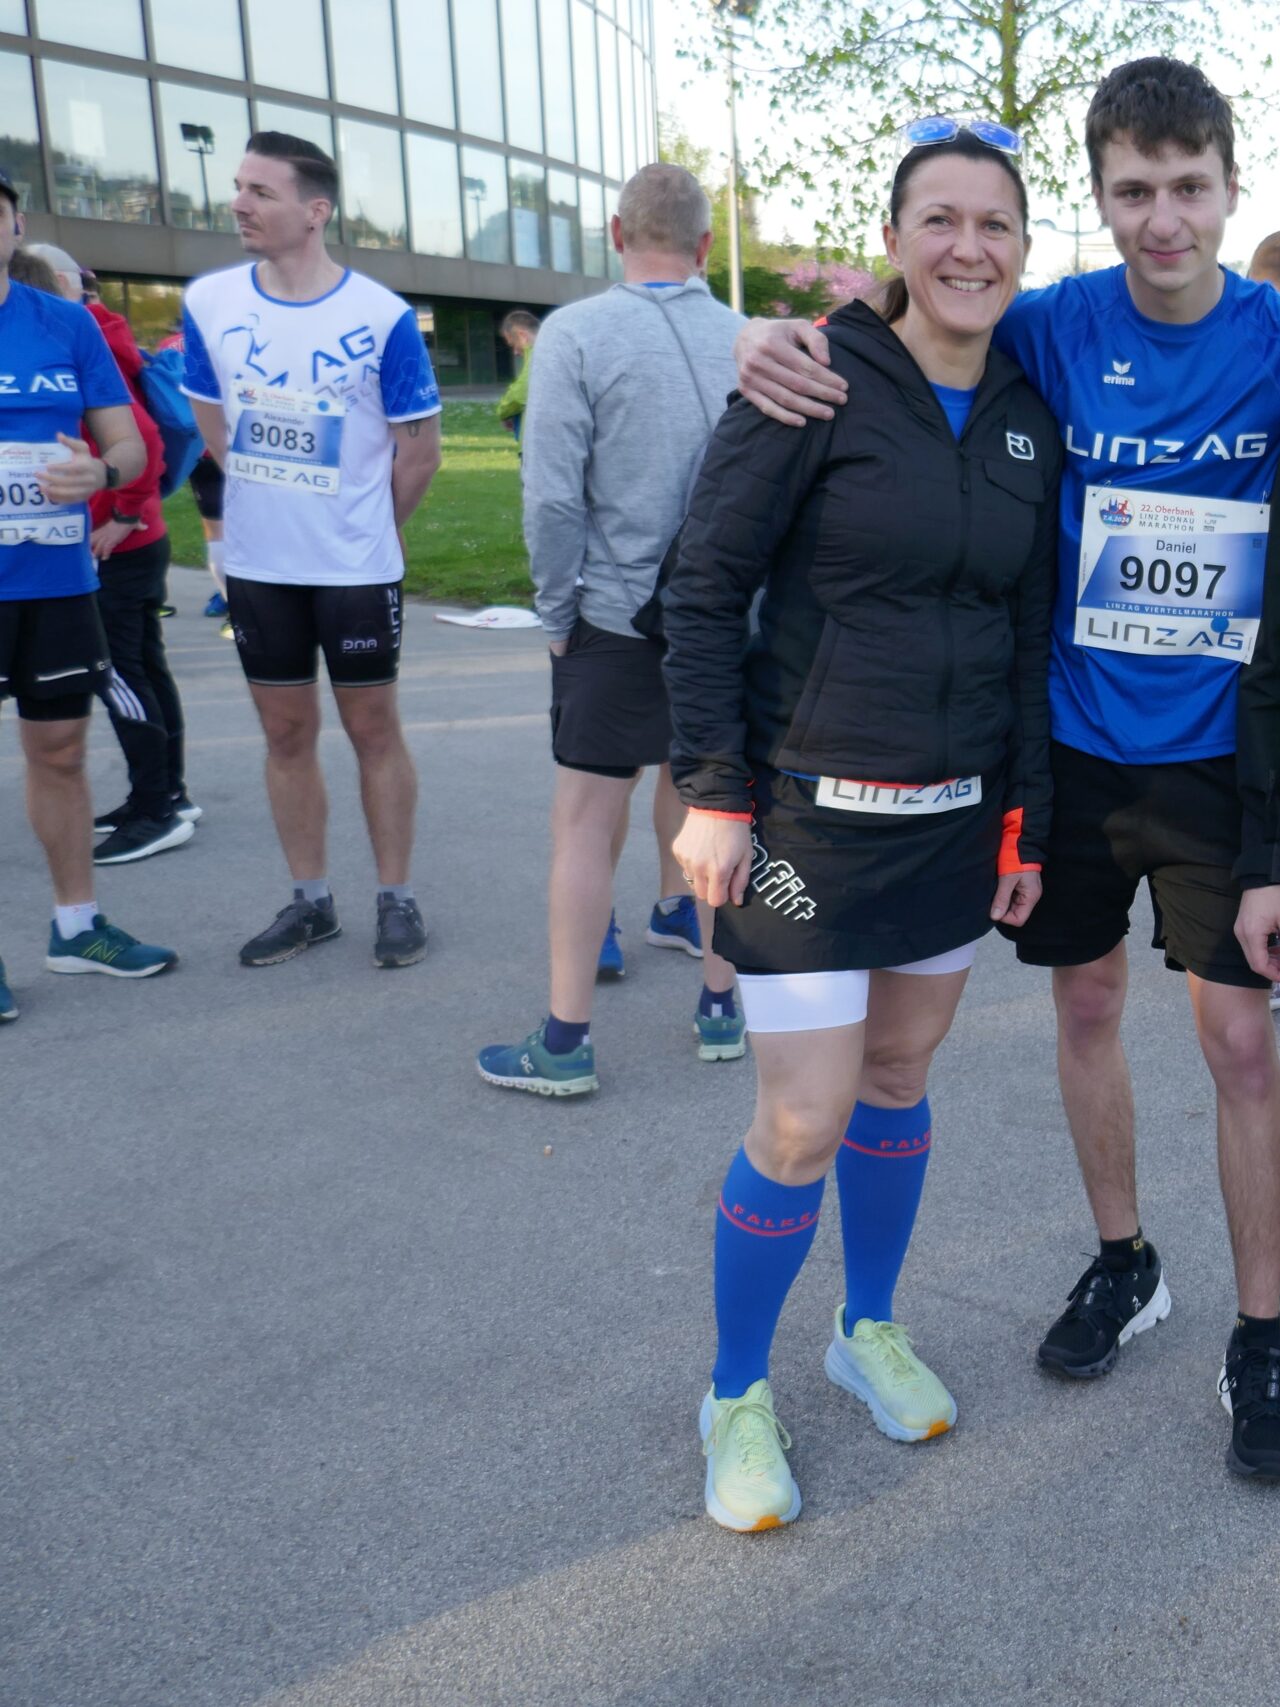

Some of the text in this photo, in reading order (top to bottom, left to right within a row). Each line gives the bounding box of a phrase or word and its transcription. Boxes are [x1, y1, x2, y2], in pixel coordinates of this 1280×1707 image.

[29, 374, 79, 393] AG
[1103, 375, 1136, 387] erima
[250, 422, 315, 454] 9083
[1066, 424, 1269, 466] LINZ AG
[9, 471, 35, 480] Haral
[235, 459, 331, 488] LINZ AG
[0, 482, 59, 506] 03
[1139, 513, 1159, 522] LINZ
[1163, 515, 1196, 525] DONAU
[1140, 504, 1153, 514] 22.
[1155, 505, 1195, 517] Oberbank
[46, 525, 79, 540] AG
[1139, 520, 1195, 533] MARATHON
[1156, 539, 1197, 554] Daniel
[1119, 555, 1227, 601] 9097
[1144, 605, 1235, 618] VIERTELMARATHON
[1087, 617, 1245, 651] LINZ AG
[732, 1203, 812, 1229] FALKE
